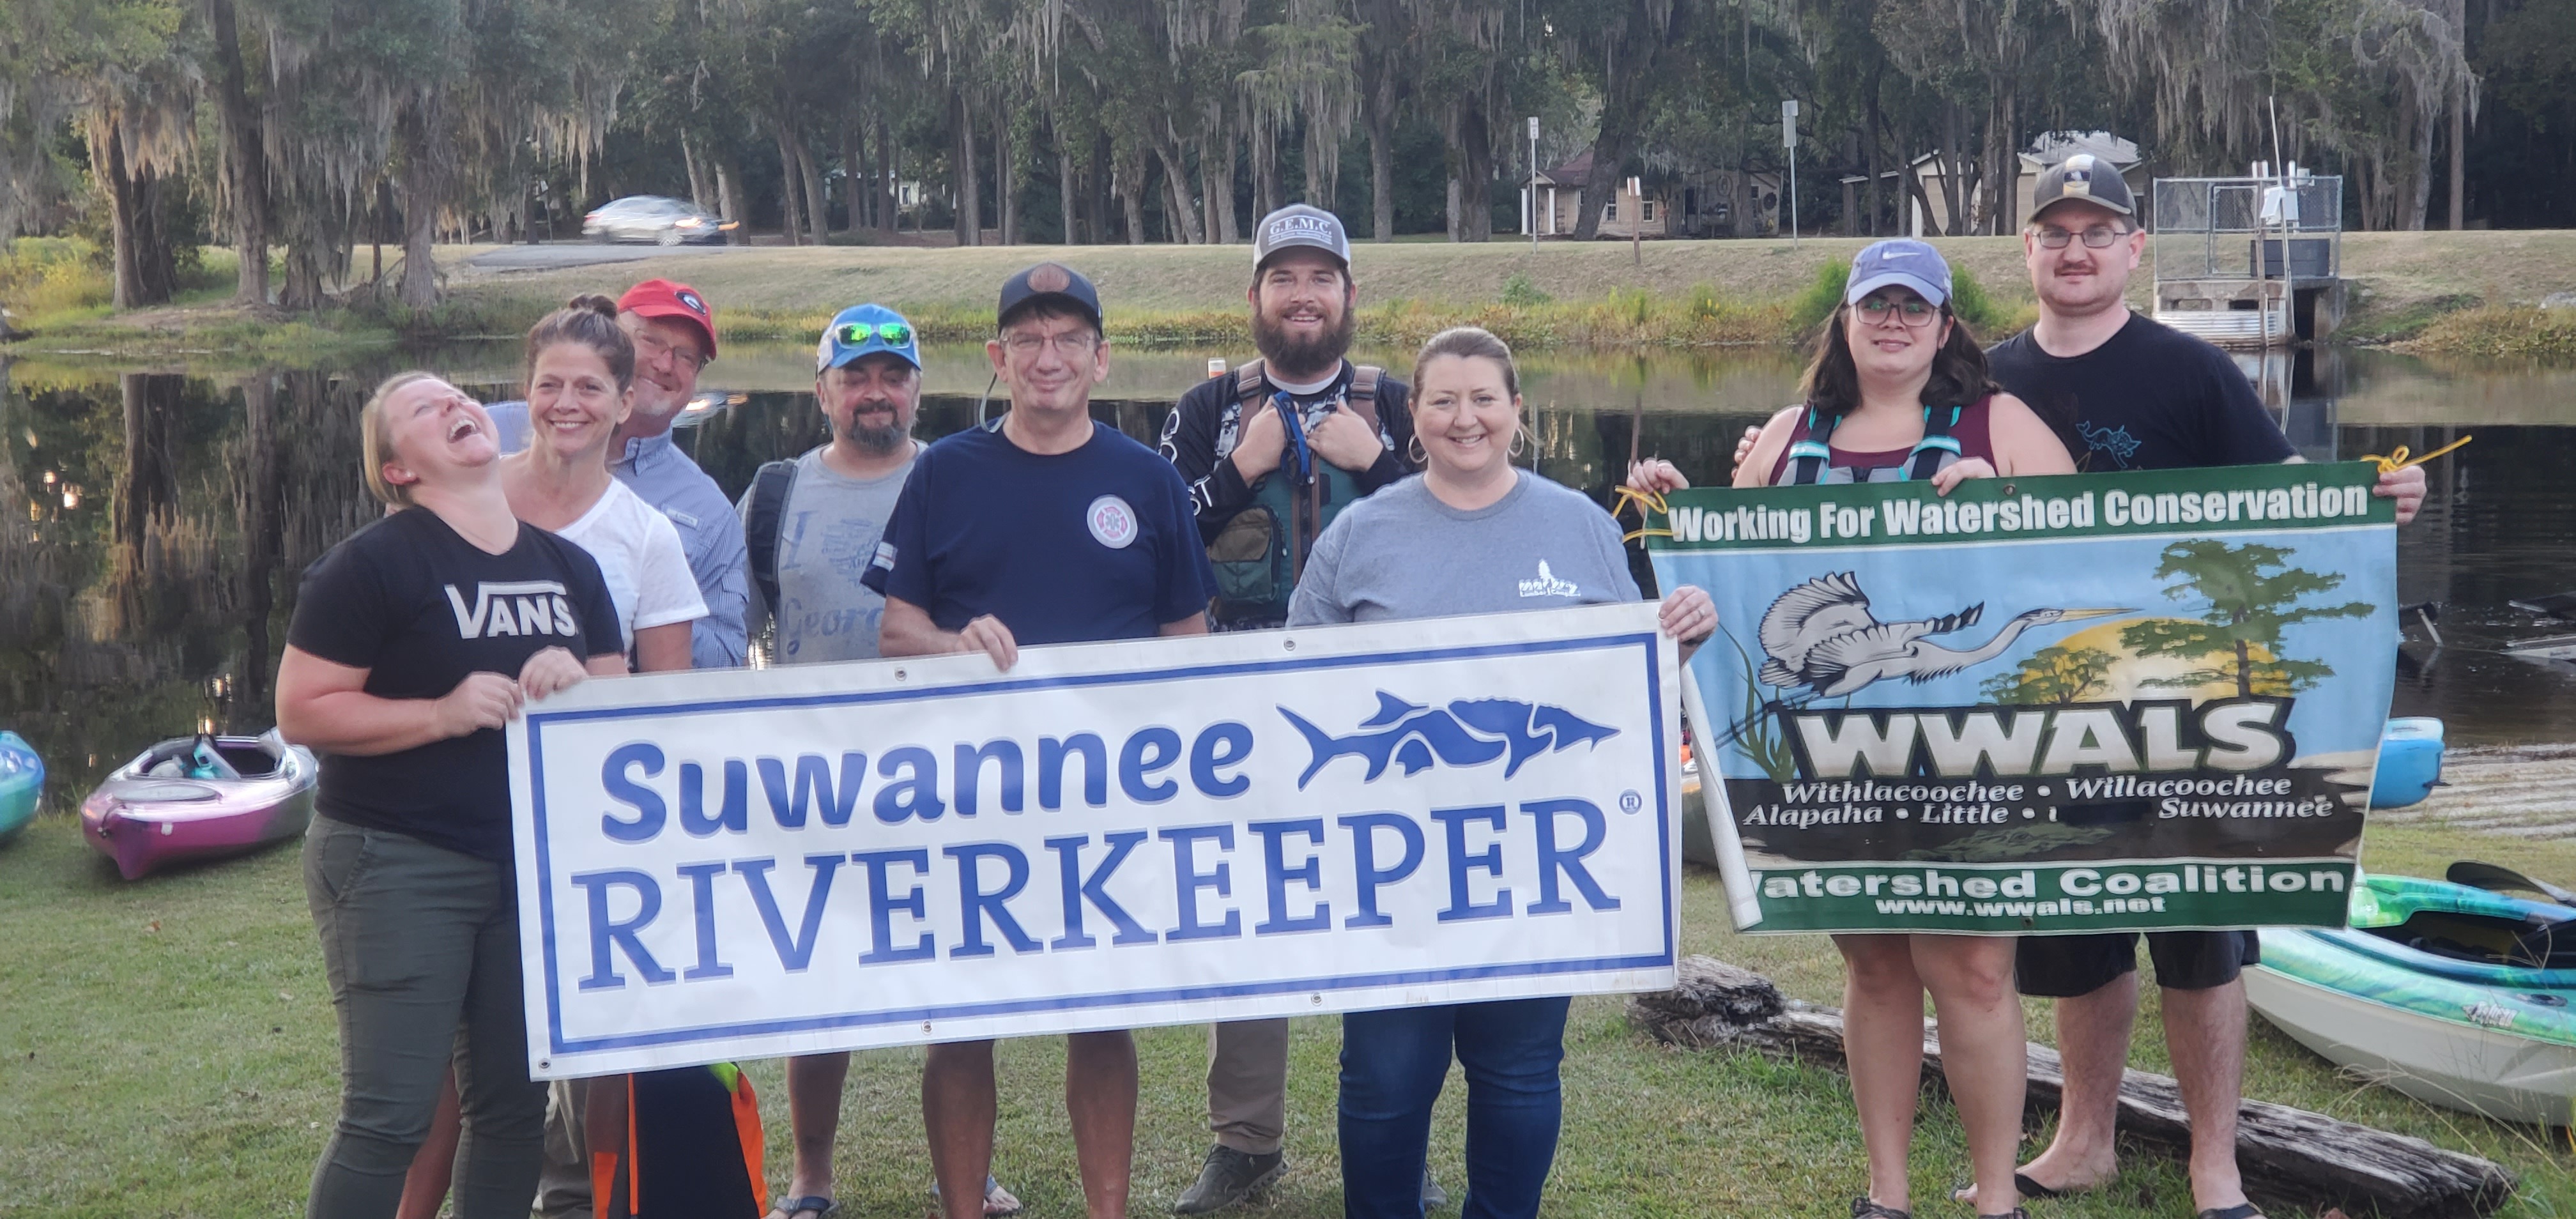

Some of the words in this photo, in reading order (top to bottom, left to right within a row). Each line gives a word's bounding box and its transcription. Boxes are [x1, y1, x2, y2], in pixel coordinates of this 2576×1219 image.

[1269, 218, 1332, 235] G.E.M.C.
[1667, 504, 1812, 544] Working
[1819, 502, 1875, 539] For
[1881, 492, 2095, 537] Watershed
[2104, 481, 2368, 527] Conservation
[444, 580, 576, 640] VANS
[1796, 702, 2283, 777] WWALS
[601, 719, 1254, 845] Suwannee
[1782, 780, 2025, 804] Withlacoochee
[2066, 774, 2292, 799] Willacoochee
[1742, 804, 1883, 829] Alapaha
[1920, 802, 2009, 824] Little
[2158, 797, 2334, 820] Suwannee
[570, 796, 1622, 993] RIVERKEEPER
[2059, 864, 2344, 896] Coalition
[1874, 896, 2167, 917] www.wwals.net
